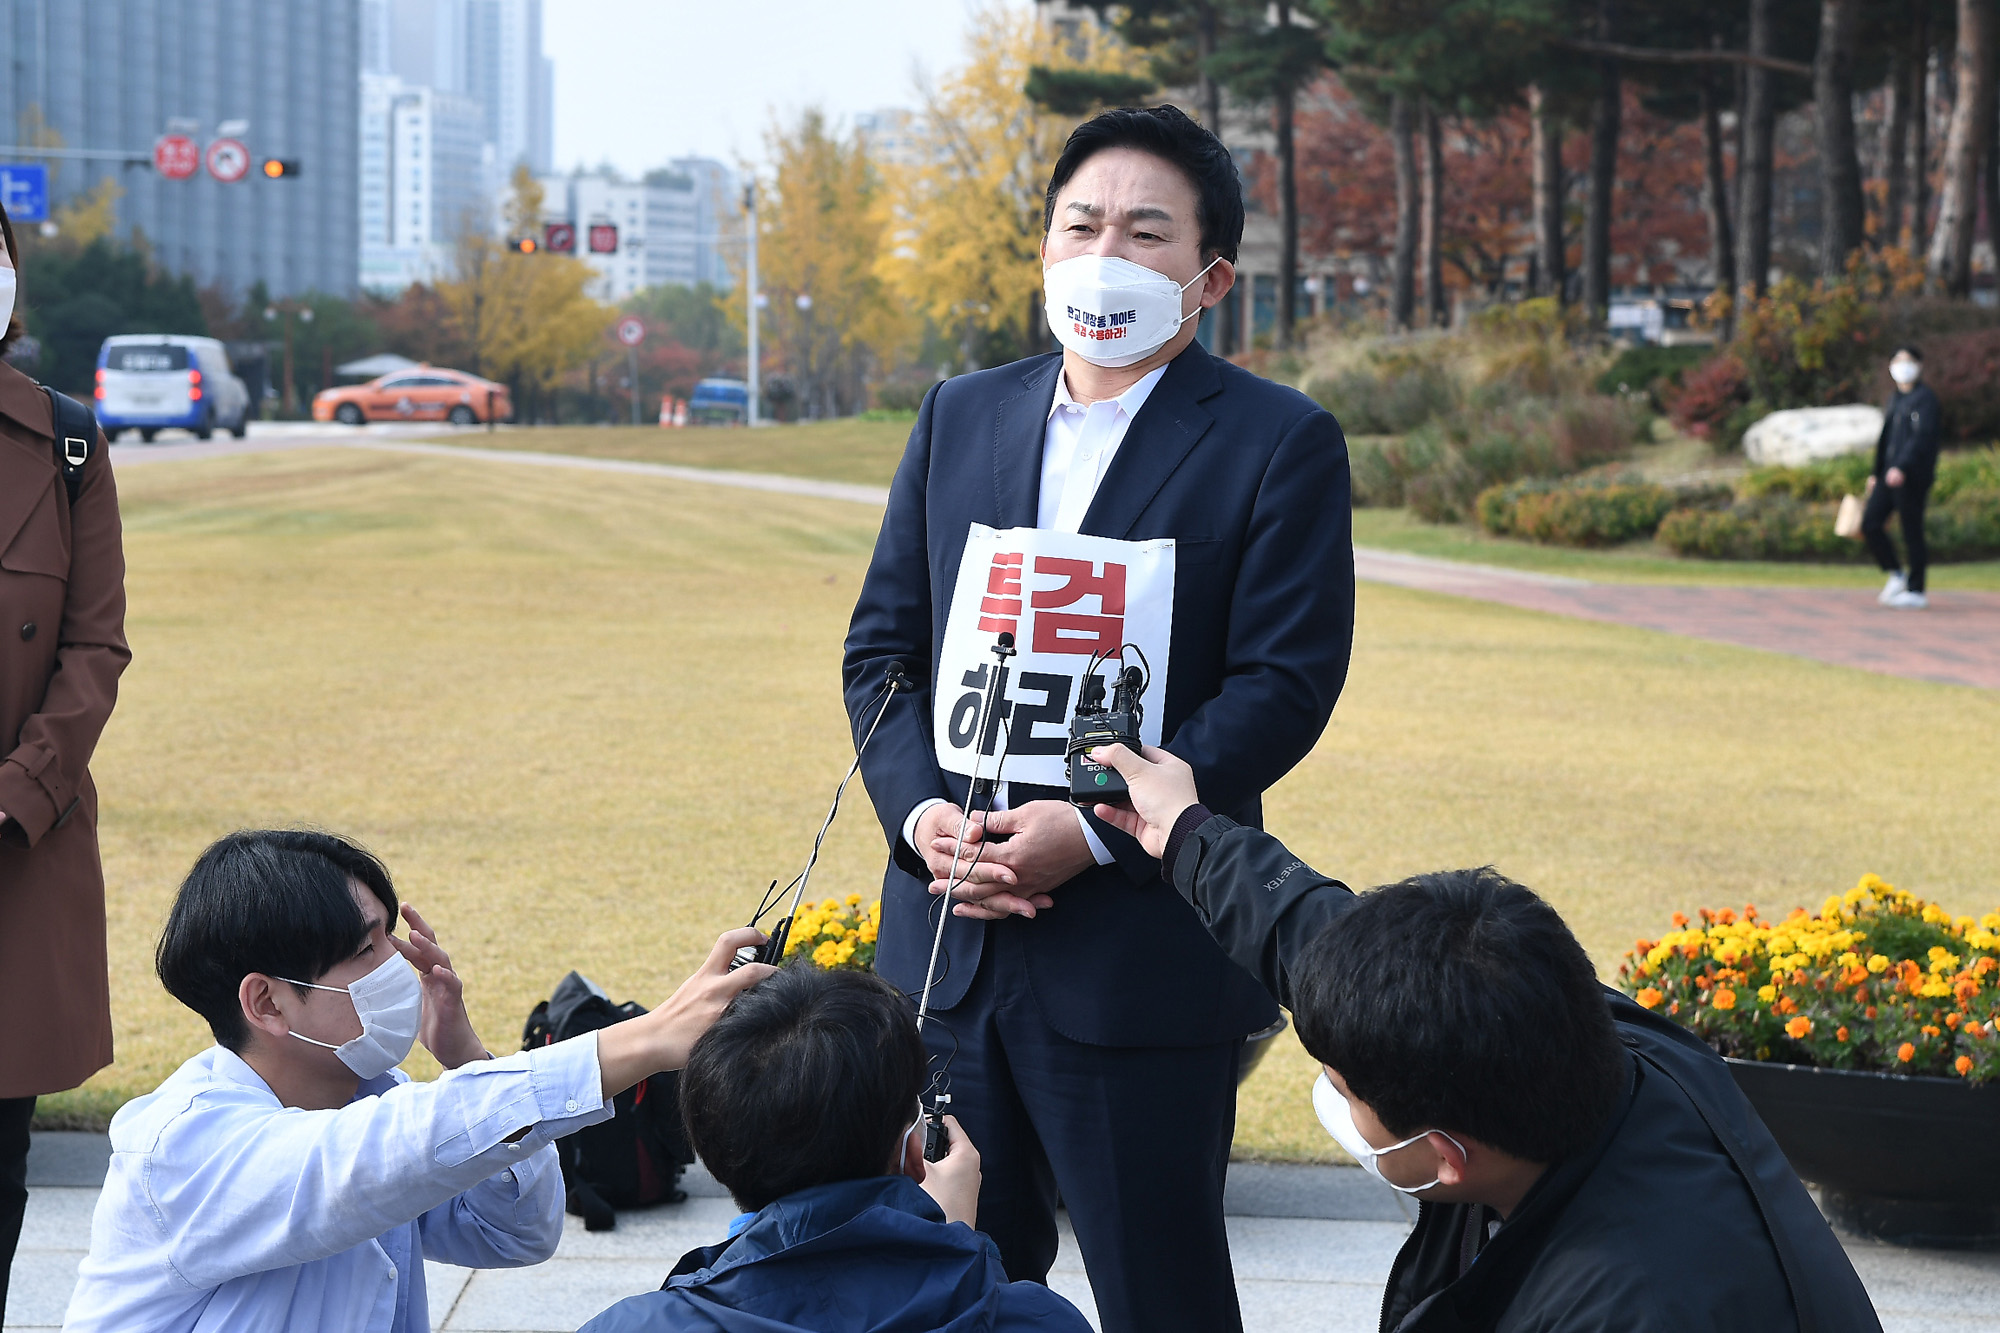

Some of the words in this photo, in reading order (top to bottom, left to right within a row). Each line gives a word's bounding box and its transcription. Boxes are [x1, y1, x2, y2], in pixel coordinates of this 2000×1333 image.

[1067, 305, 1081, 322] 판교
[1083, 311, 1106, 328] 대장동
[1109, 309, 1136, 327] 게이트
[1074, 323, 1087, 337] 특검
[1088, 327, 1127, 340] 수용하라!
[978, 553, 1126, 659] 특검
